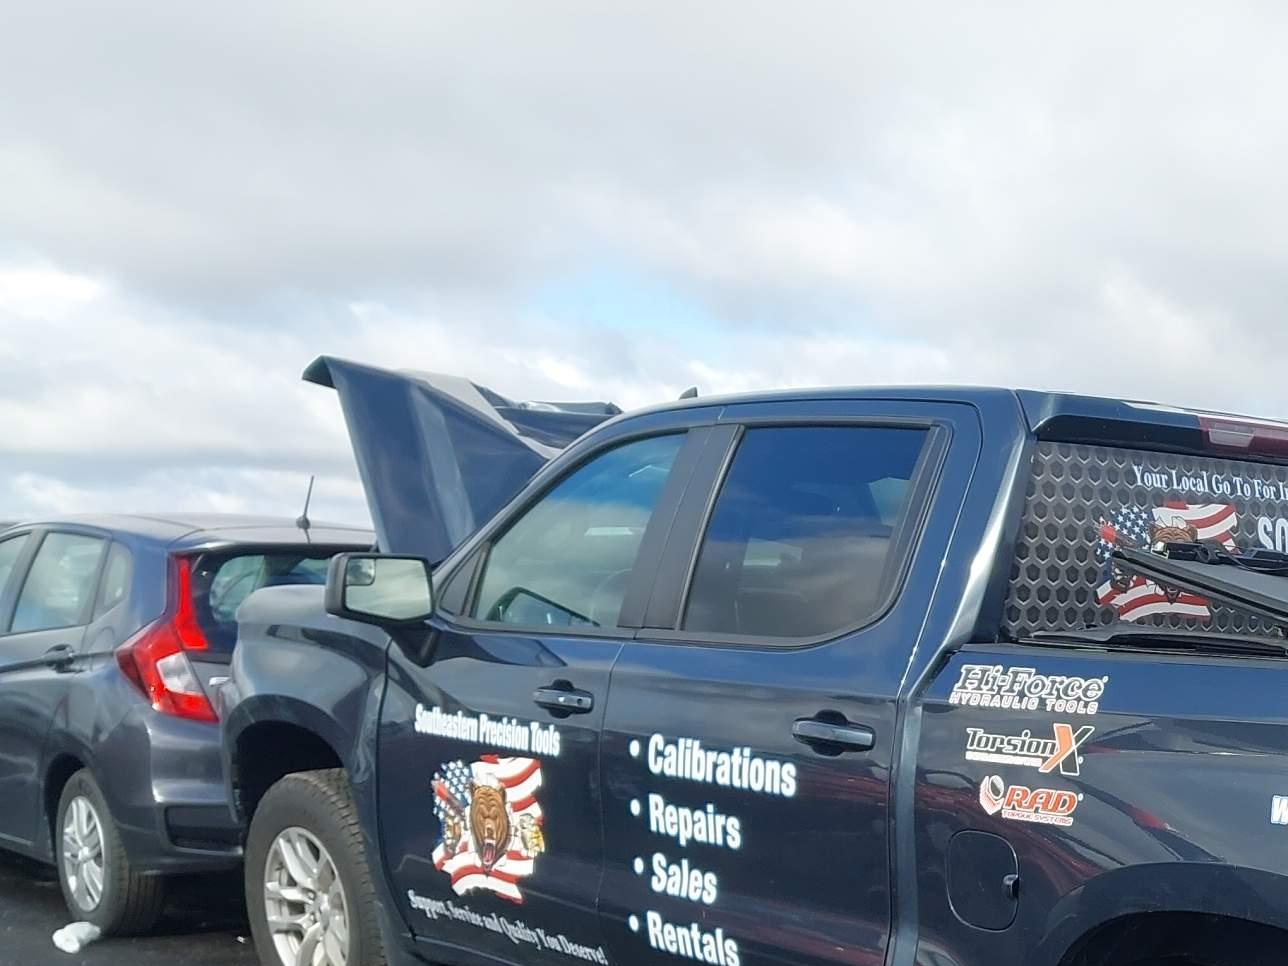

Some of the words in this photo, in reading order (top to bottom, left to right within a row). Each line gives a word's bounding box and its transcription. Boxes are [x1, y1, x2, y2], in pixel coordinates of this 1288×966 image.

[1133, 464, 1168, 489] Your
[1172, 470, 1208, 493] Local
[1212, 474, 1231, 495] Go
[1233, 477, 1251, 497] To
[1254, 479, 1277, 499] For
[949, 691, 1039, 710] HYDRAULIC
[1045, 699, 1099, 715] TOOLS
[953, 664, 1105, 702] Hi-Force
[414, 703, 478, 743] Southeastern
[479, 713, 530, 751] Precision
[529, 721, 561, 757] Tools
[648, 733, 797, 798] Calibrations
[648, 793, 742, 850] Repairs
[1002, 785, 1078, 816] RAD
[651, 852, 718, 905] Sales
[450, 901, 483, 928] Service
[482, 912, 503, 934] and
[500, 916, 542, 951] Quality
[536, 928, 563, 953] You
[558, 934, 609, 966] Deserve!
